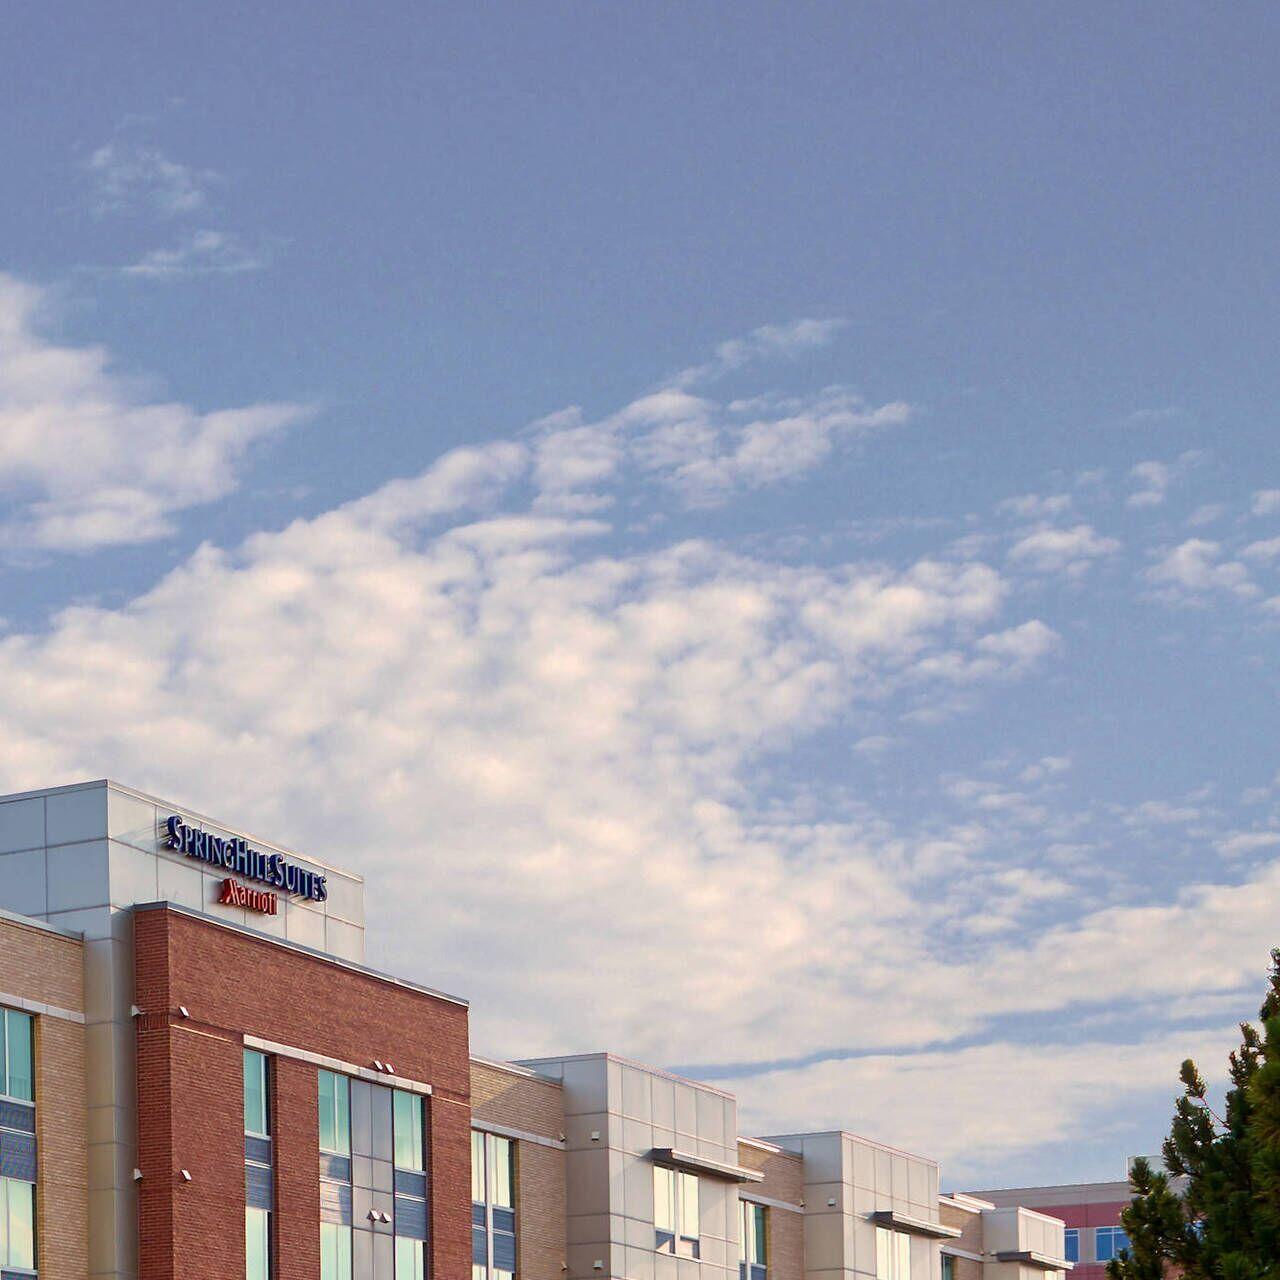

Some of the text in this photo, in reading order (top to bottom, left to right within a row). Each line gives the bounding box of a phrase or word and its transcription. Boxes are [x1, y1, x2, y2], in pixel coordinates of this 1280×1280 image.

[167, 815, 328, 901] SPRINGHILL SUITES
[220, 877, 279, 915] Marriott
